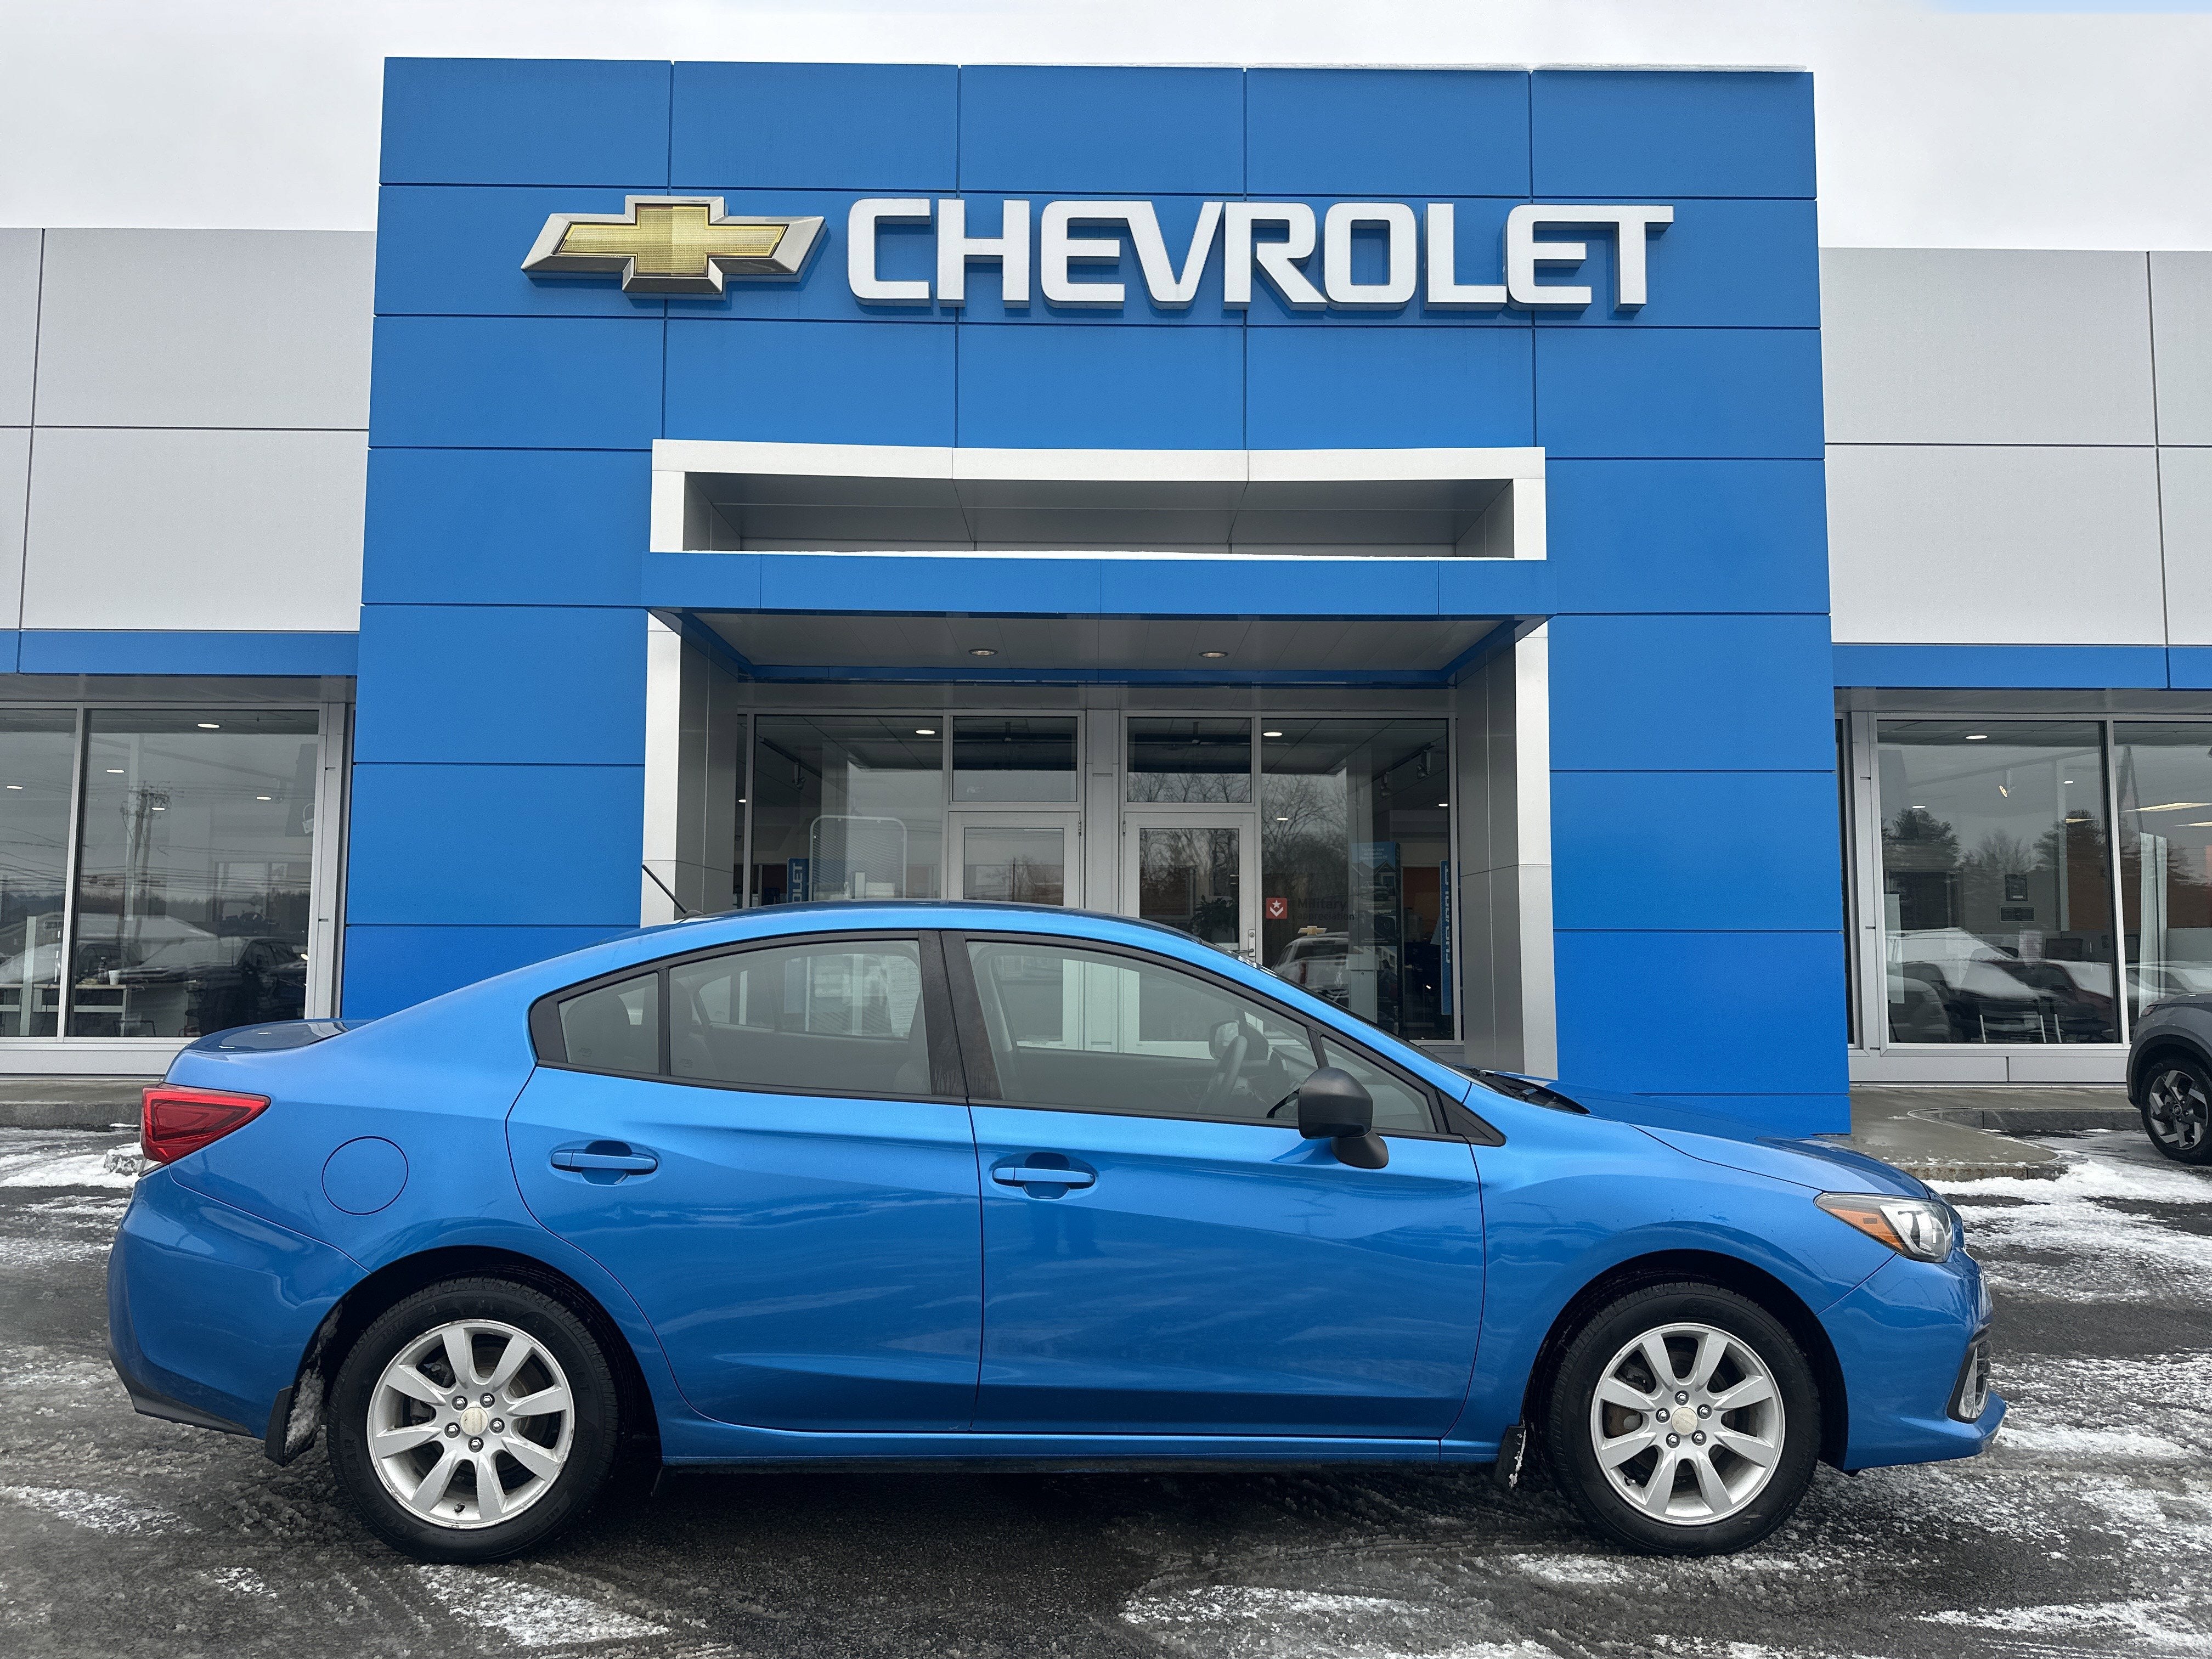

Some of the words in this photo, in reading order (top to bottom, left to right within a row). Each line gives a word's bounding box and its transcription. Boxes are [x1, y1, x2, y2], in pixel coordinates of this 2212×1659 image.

[847, 198, 1674, 312] CHEVROLET
[1298, 898, 1348, 911] Military
[1297, 912, 1355, 922] appreciation
